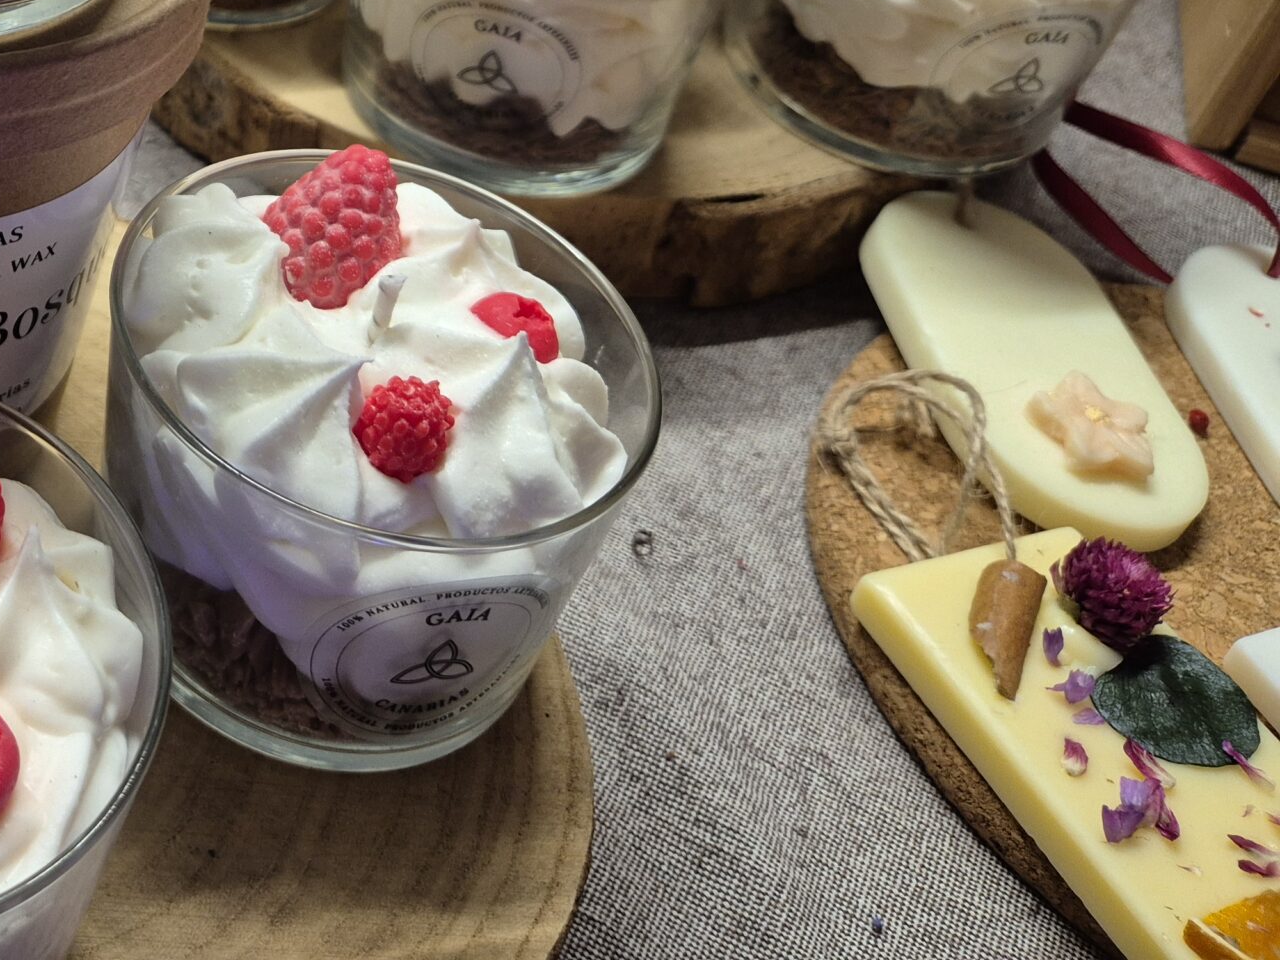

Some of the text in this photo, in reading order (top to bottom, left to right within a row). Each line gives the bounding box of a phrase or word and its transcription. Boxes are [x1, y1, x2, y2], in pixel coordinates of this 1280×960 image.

[473, 18, 524, 44] GAIA
[10, 242, 58, 273] WAX
[336, 614, 365, 632] 100%
[436, 586, 511, 601] PRODUCTOS
[425, 607, 492, 627] GAIA
[375, 687, 470, 714] CANARIAS
